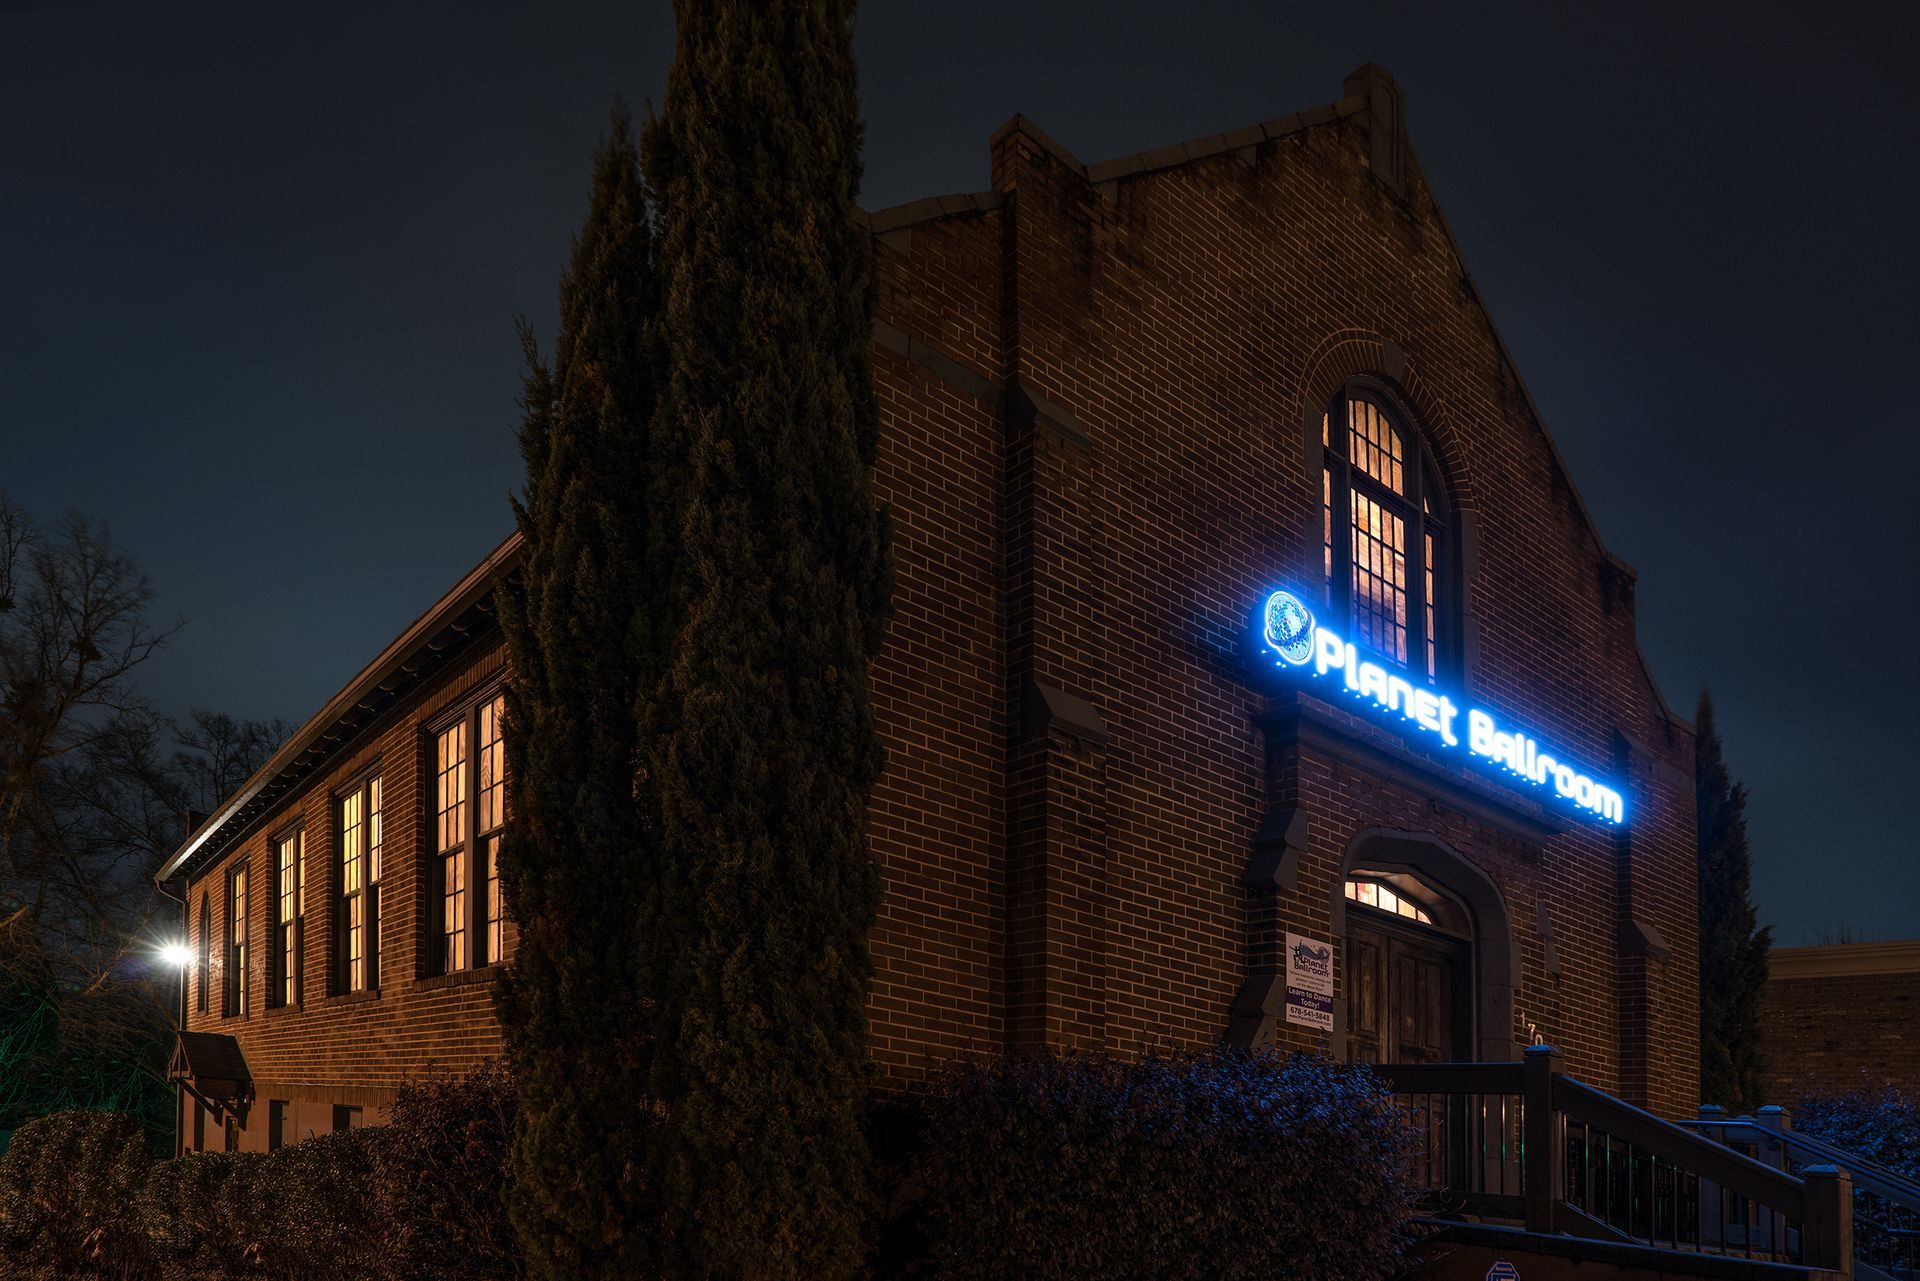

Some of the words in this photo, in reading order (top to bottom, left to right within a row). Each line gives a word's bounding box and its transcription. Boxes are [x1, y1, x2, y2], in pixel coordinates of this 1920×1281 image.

[1288, 987, 1305, 998] Learn
[1305, 991, 1313, 999] to
[1313, 992, 1332, 1003] Dance
[1300, 997, 1320, 1010] Today!
